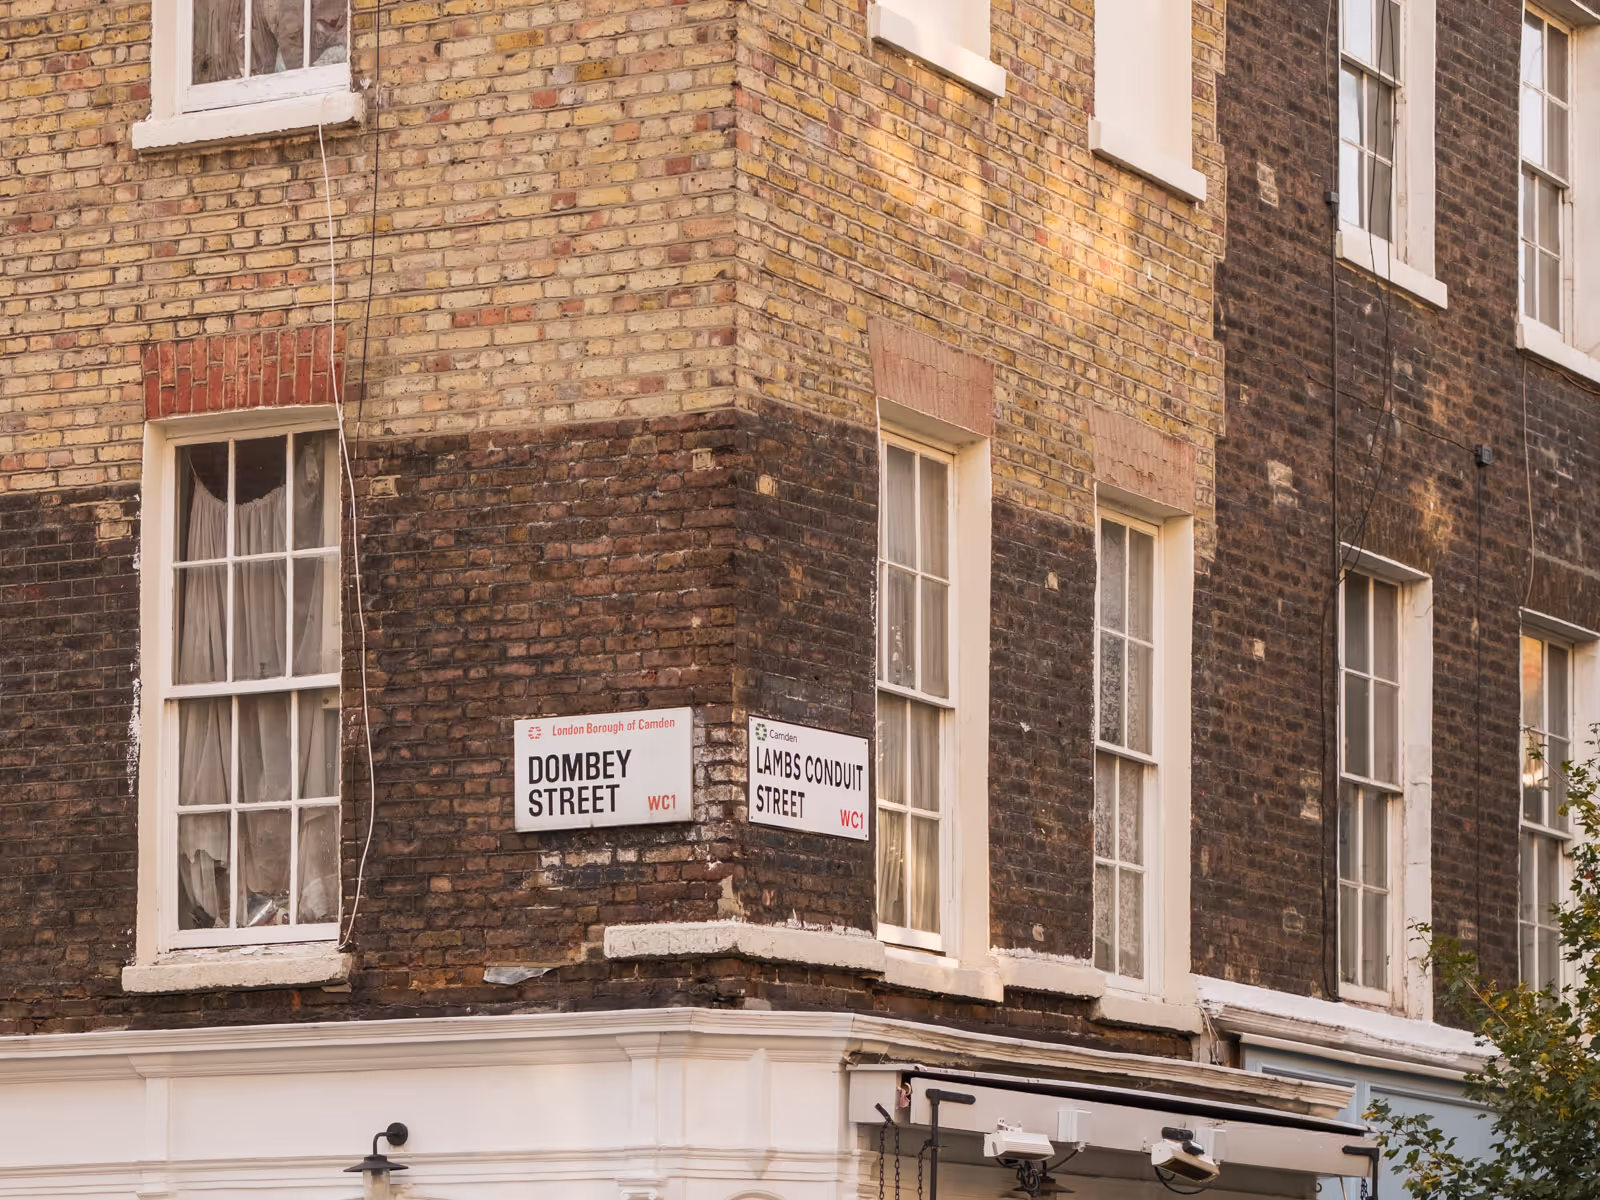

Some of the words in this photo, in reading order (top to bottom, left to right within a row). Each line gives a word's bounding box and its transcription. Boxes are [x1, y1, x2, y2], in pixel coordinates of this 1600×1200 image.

[552, 725, 583, 737] London
[586, 722, 624, 736] Borough
[626, 720, 637, 731] of
[638, 717, 675, 730] Camden
[769, 728, 798, 743] Camden
[528, 749, 631, 785] DOMBEY
[756, 746, 801, 780] LAMBS
[805, 758, 863, 791] CONDUIT
[528, 784, 620, 817] STREET
[647, 794, 676, 811] WC1
[756, 789, 805, 819] STREET
[840, 809, 864, 830] WC1
